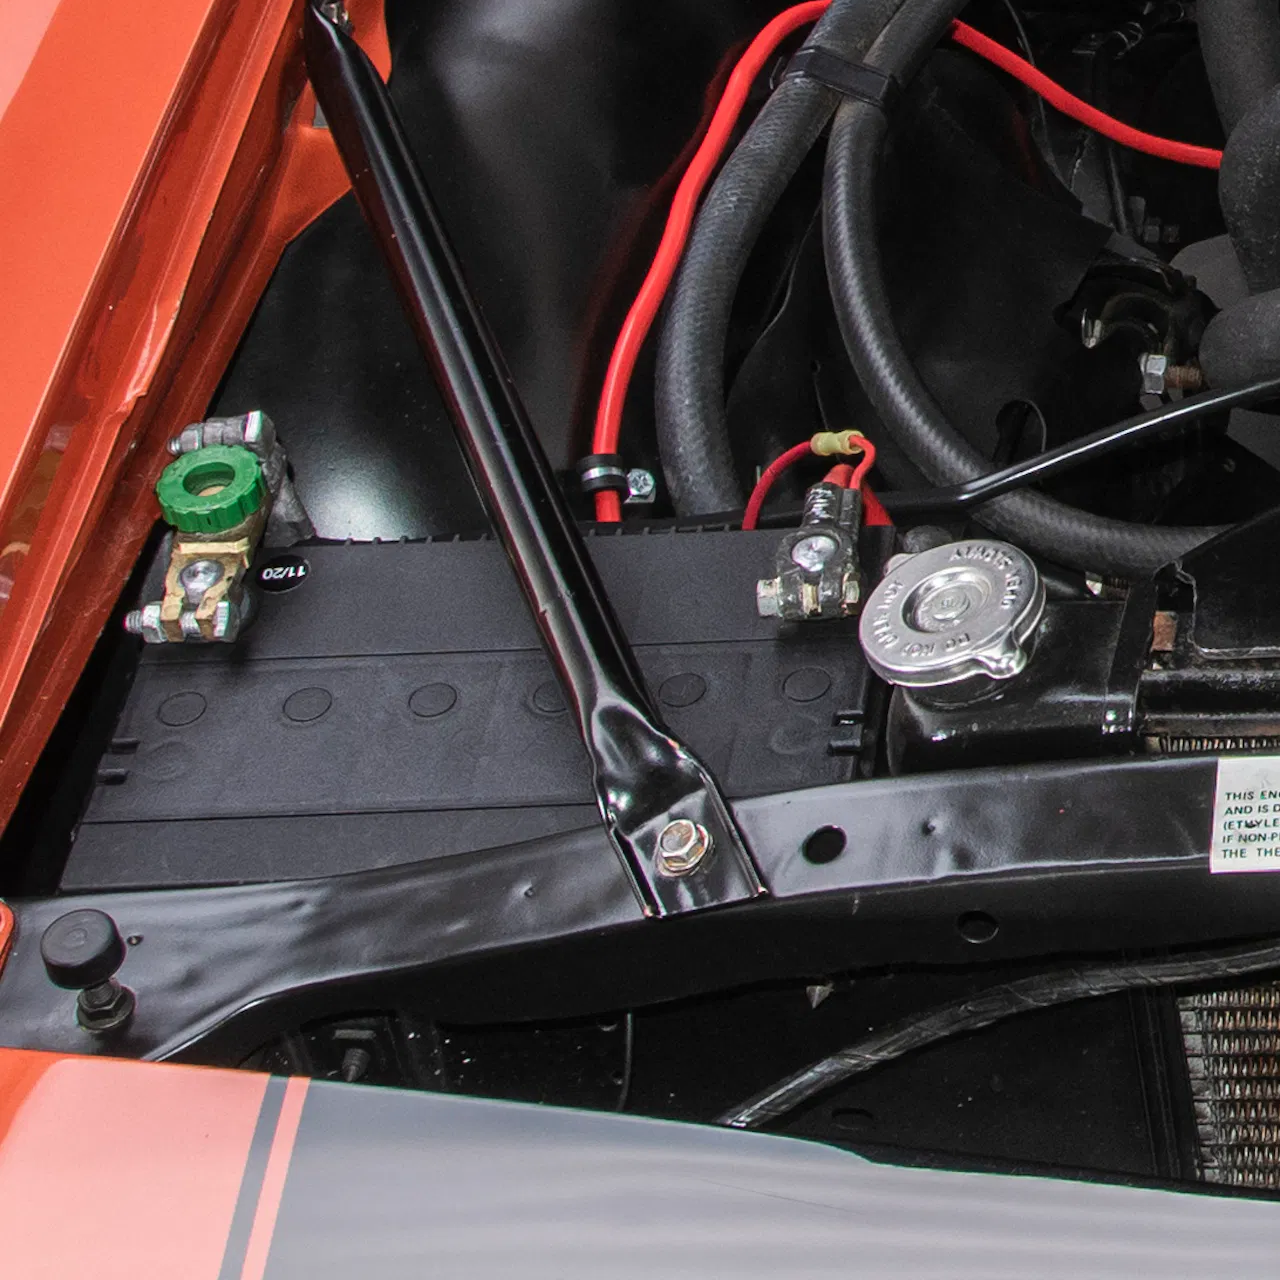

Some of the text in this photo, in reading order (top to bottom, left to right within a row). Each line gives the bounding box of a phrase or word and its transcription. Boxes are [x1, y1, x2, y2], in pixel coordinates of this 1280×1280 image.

[261, 565, 306, 581] 11/20
[1225, 791, 1253, 800] THIS
[1224, 805, 1252, 814] AND
[1257, 804, 1268, 813] IS
[1222, 833, 1233, 843] IF
[1222, 848, 1246, 858] THE
